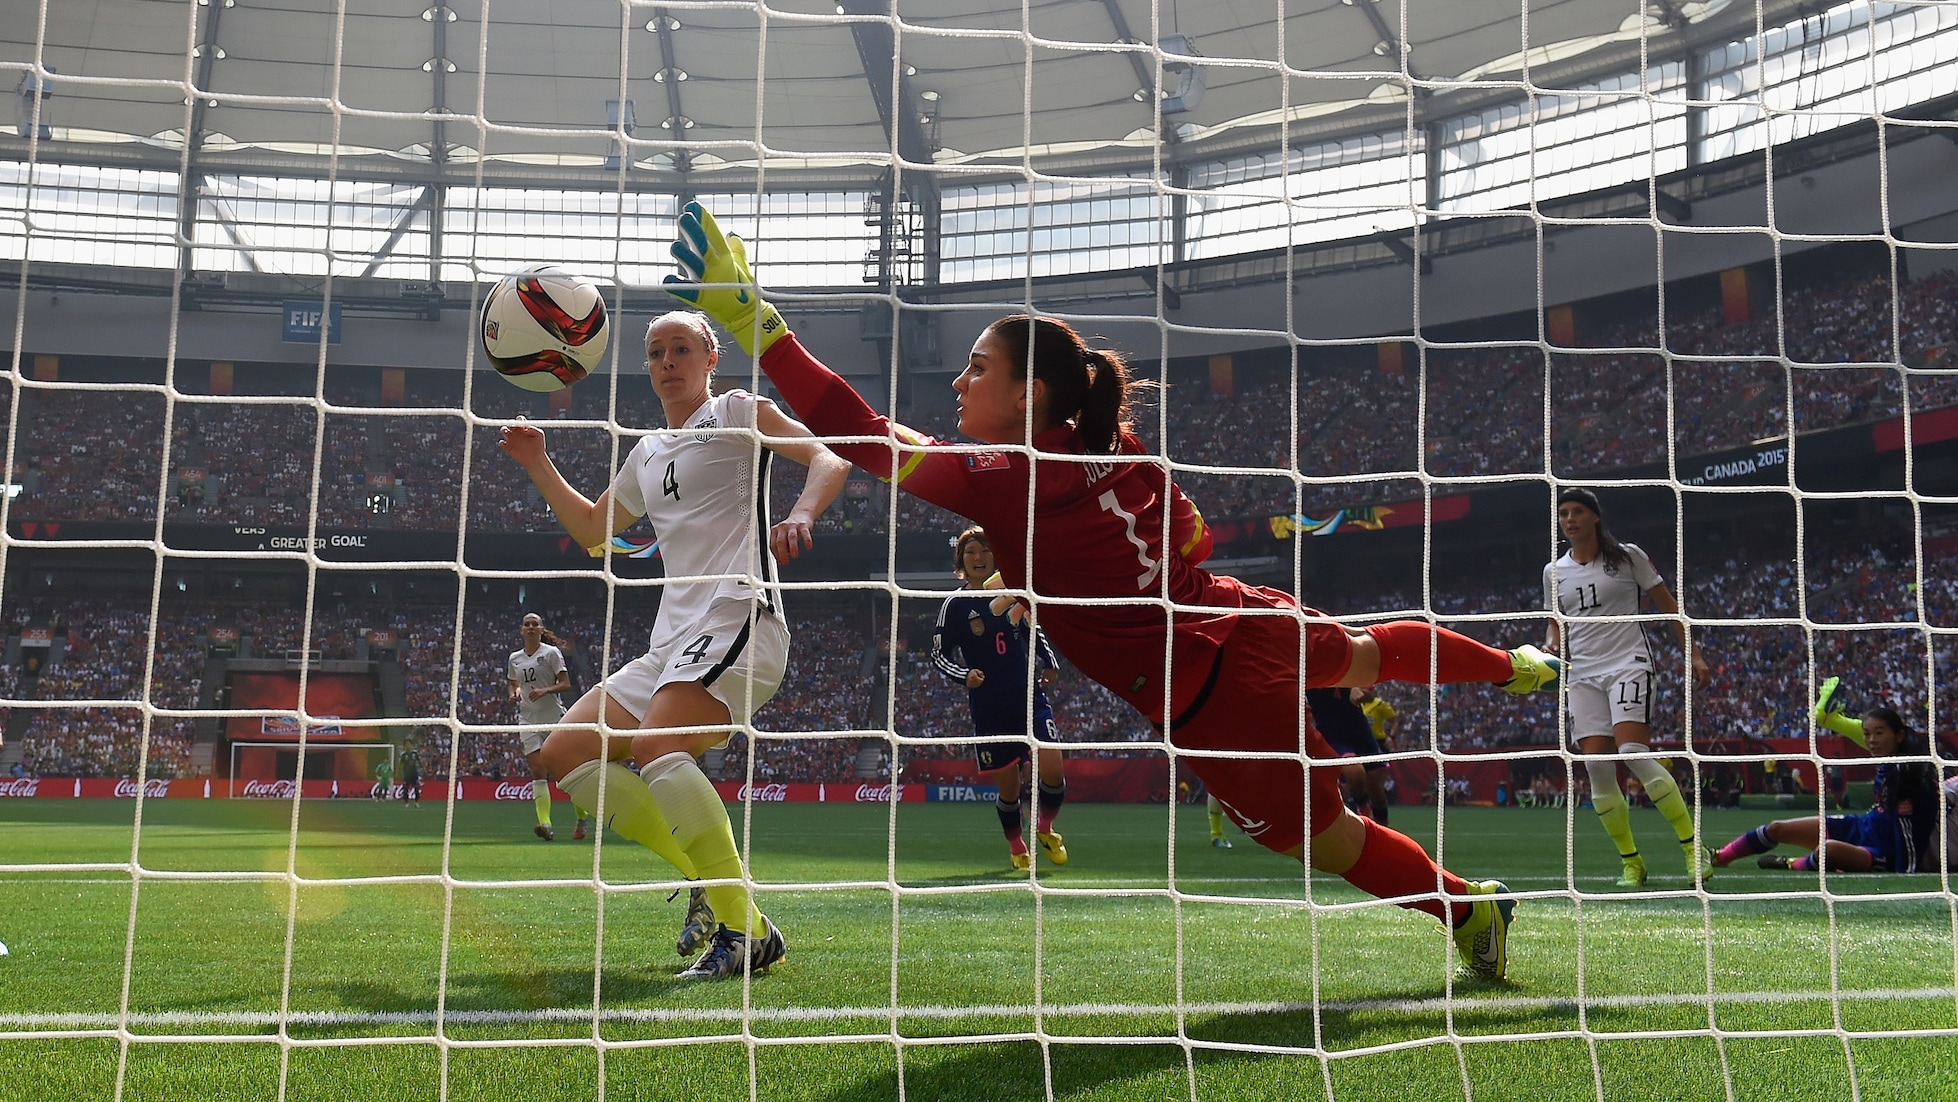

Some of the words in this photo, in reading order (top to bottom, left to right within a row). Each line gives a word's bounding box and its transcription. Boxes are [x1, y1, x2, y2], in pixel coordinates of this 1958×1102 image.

[291, 311, 332, 327] FIFA
[762, 313, 782, 334] SOLO
[663, 459, 681, 502] 4
[1705, 459, 1757, 481] CANADA
[270, 537, 327, 549] GREATER
[1098, 488, 1163, 591] 1
[1575, 583, 1602, 611] 11
[682, 634, 714, 664] 4
[995, 631, 1007, 655] 6
[523, 667, 537, 683] 12
[1617, 681, 1643, 705] 11
[0, 778, 40, 797] ca-Cola
[114, 778, 171, 798] CocaCola
[495, 781, 535, 800] Coca-Co
[737, 783, 788, 802] Cca-Cola
